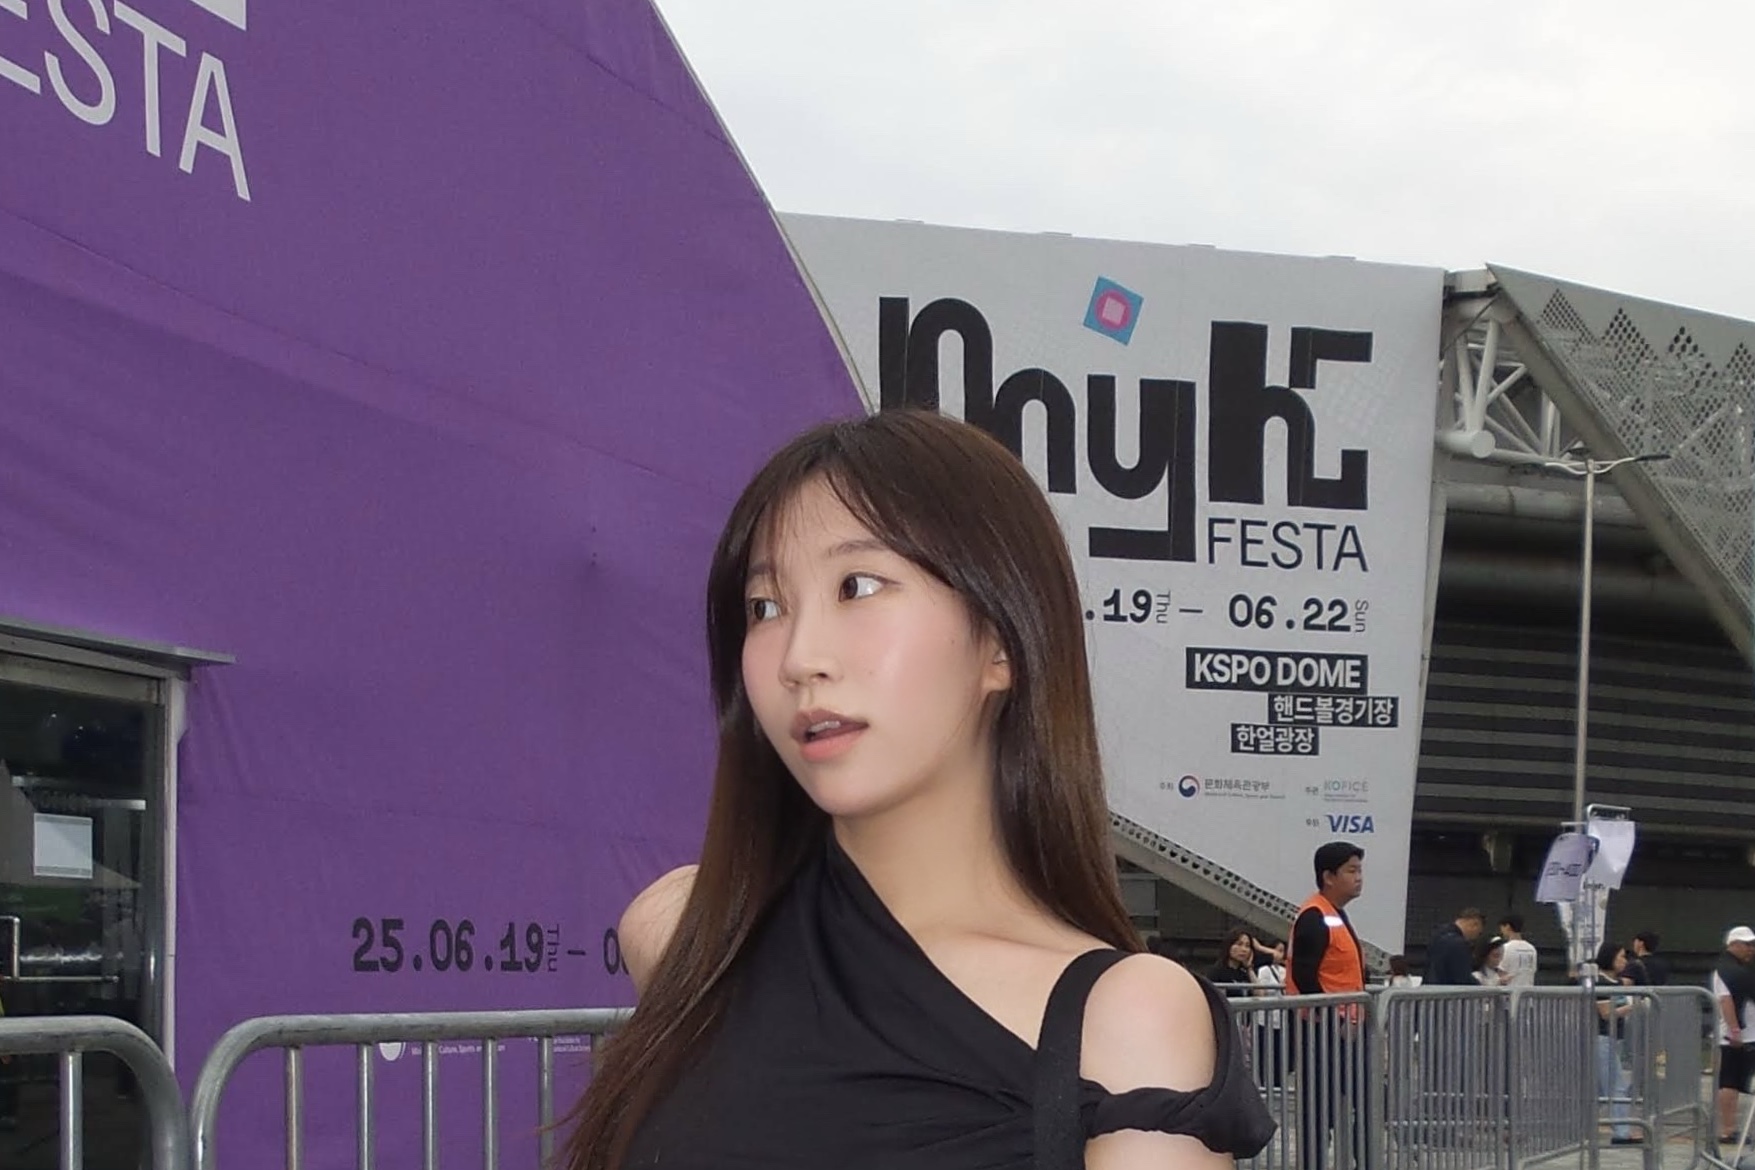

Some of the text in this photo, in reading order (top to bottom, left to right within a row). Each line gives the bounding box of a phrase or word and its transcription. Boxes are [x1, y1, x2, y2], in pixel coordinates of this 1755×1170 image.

[1207, 517, 1369, 573] FESTA
[1155, 590, 1172, 625] Thu
[1228, 593, 1352, 632] 06.22
[1354, 599, 1370, 634] Sun
[1193, 652, 1361, 690] KSPO DOME
[1273, 694, 1394, 726] 핸드볼경기장
[1235, 724, 1315, 754] 한얼광장
[1324, 814, 1375, 833] VISA
[352, 916, 544, 973] 25.06.19
[547, 923, 560, 973] Thu
